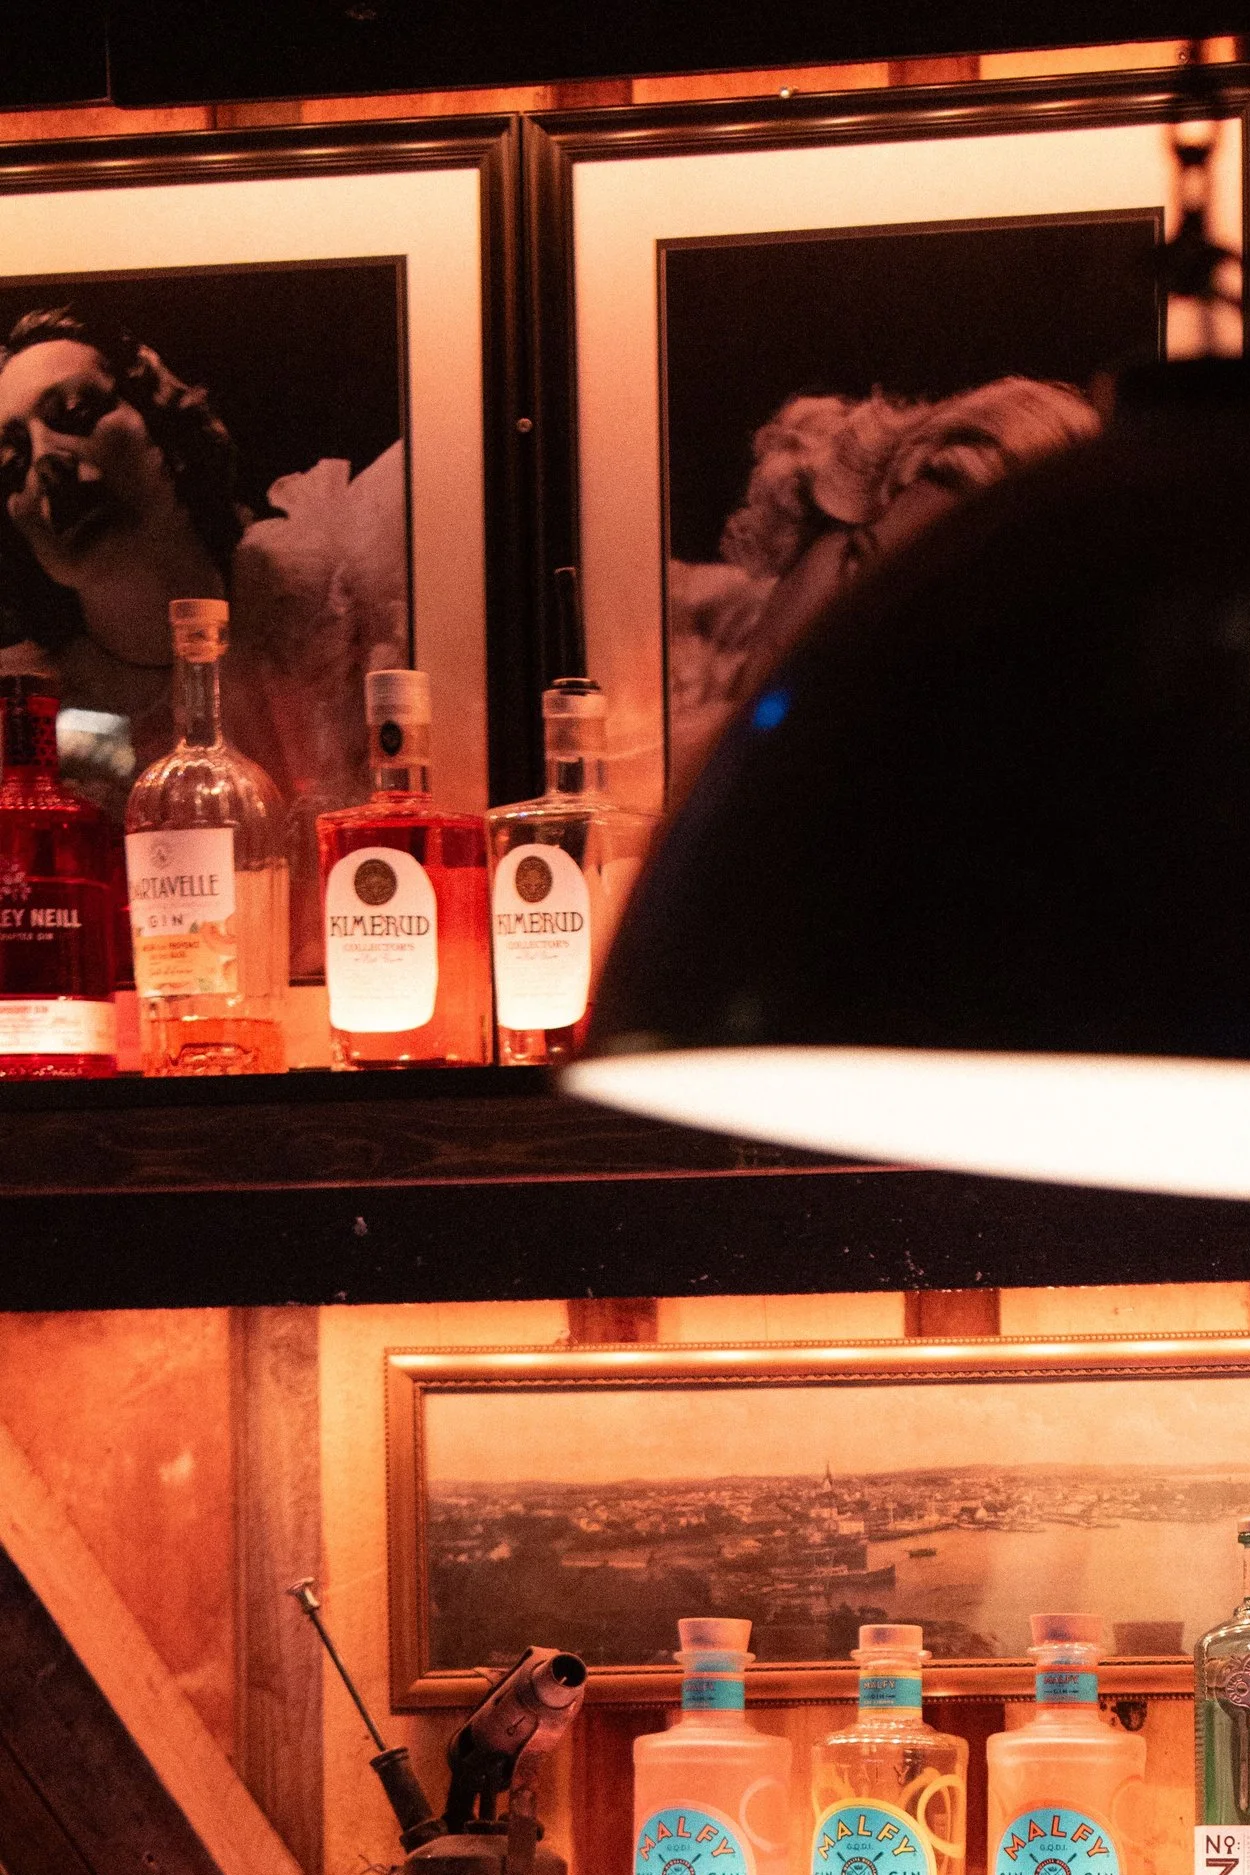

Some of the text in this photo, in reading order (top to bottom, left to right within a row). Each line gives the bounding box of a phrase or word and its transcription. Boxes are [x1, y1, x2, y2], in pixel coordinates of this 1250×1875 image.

[0, 909, 82, 928] EY NEILL
[149, 914, 184, 928] GIN
[330, 914, 430, 937] KIMERUD
[496, 911, 584, 935] KIMERUD
[639, 1816, 736, 1861] MALFY
[818, 1814, 917, 1861] MALFY
[1003, 1815, 1110, 1861] MALFY
